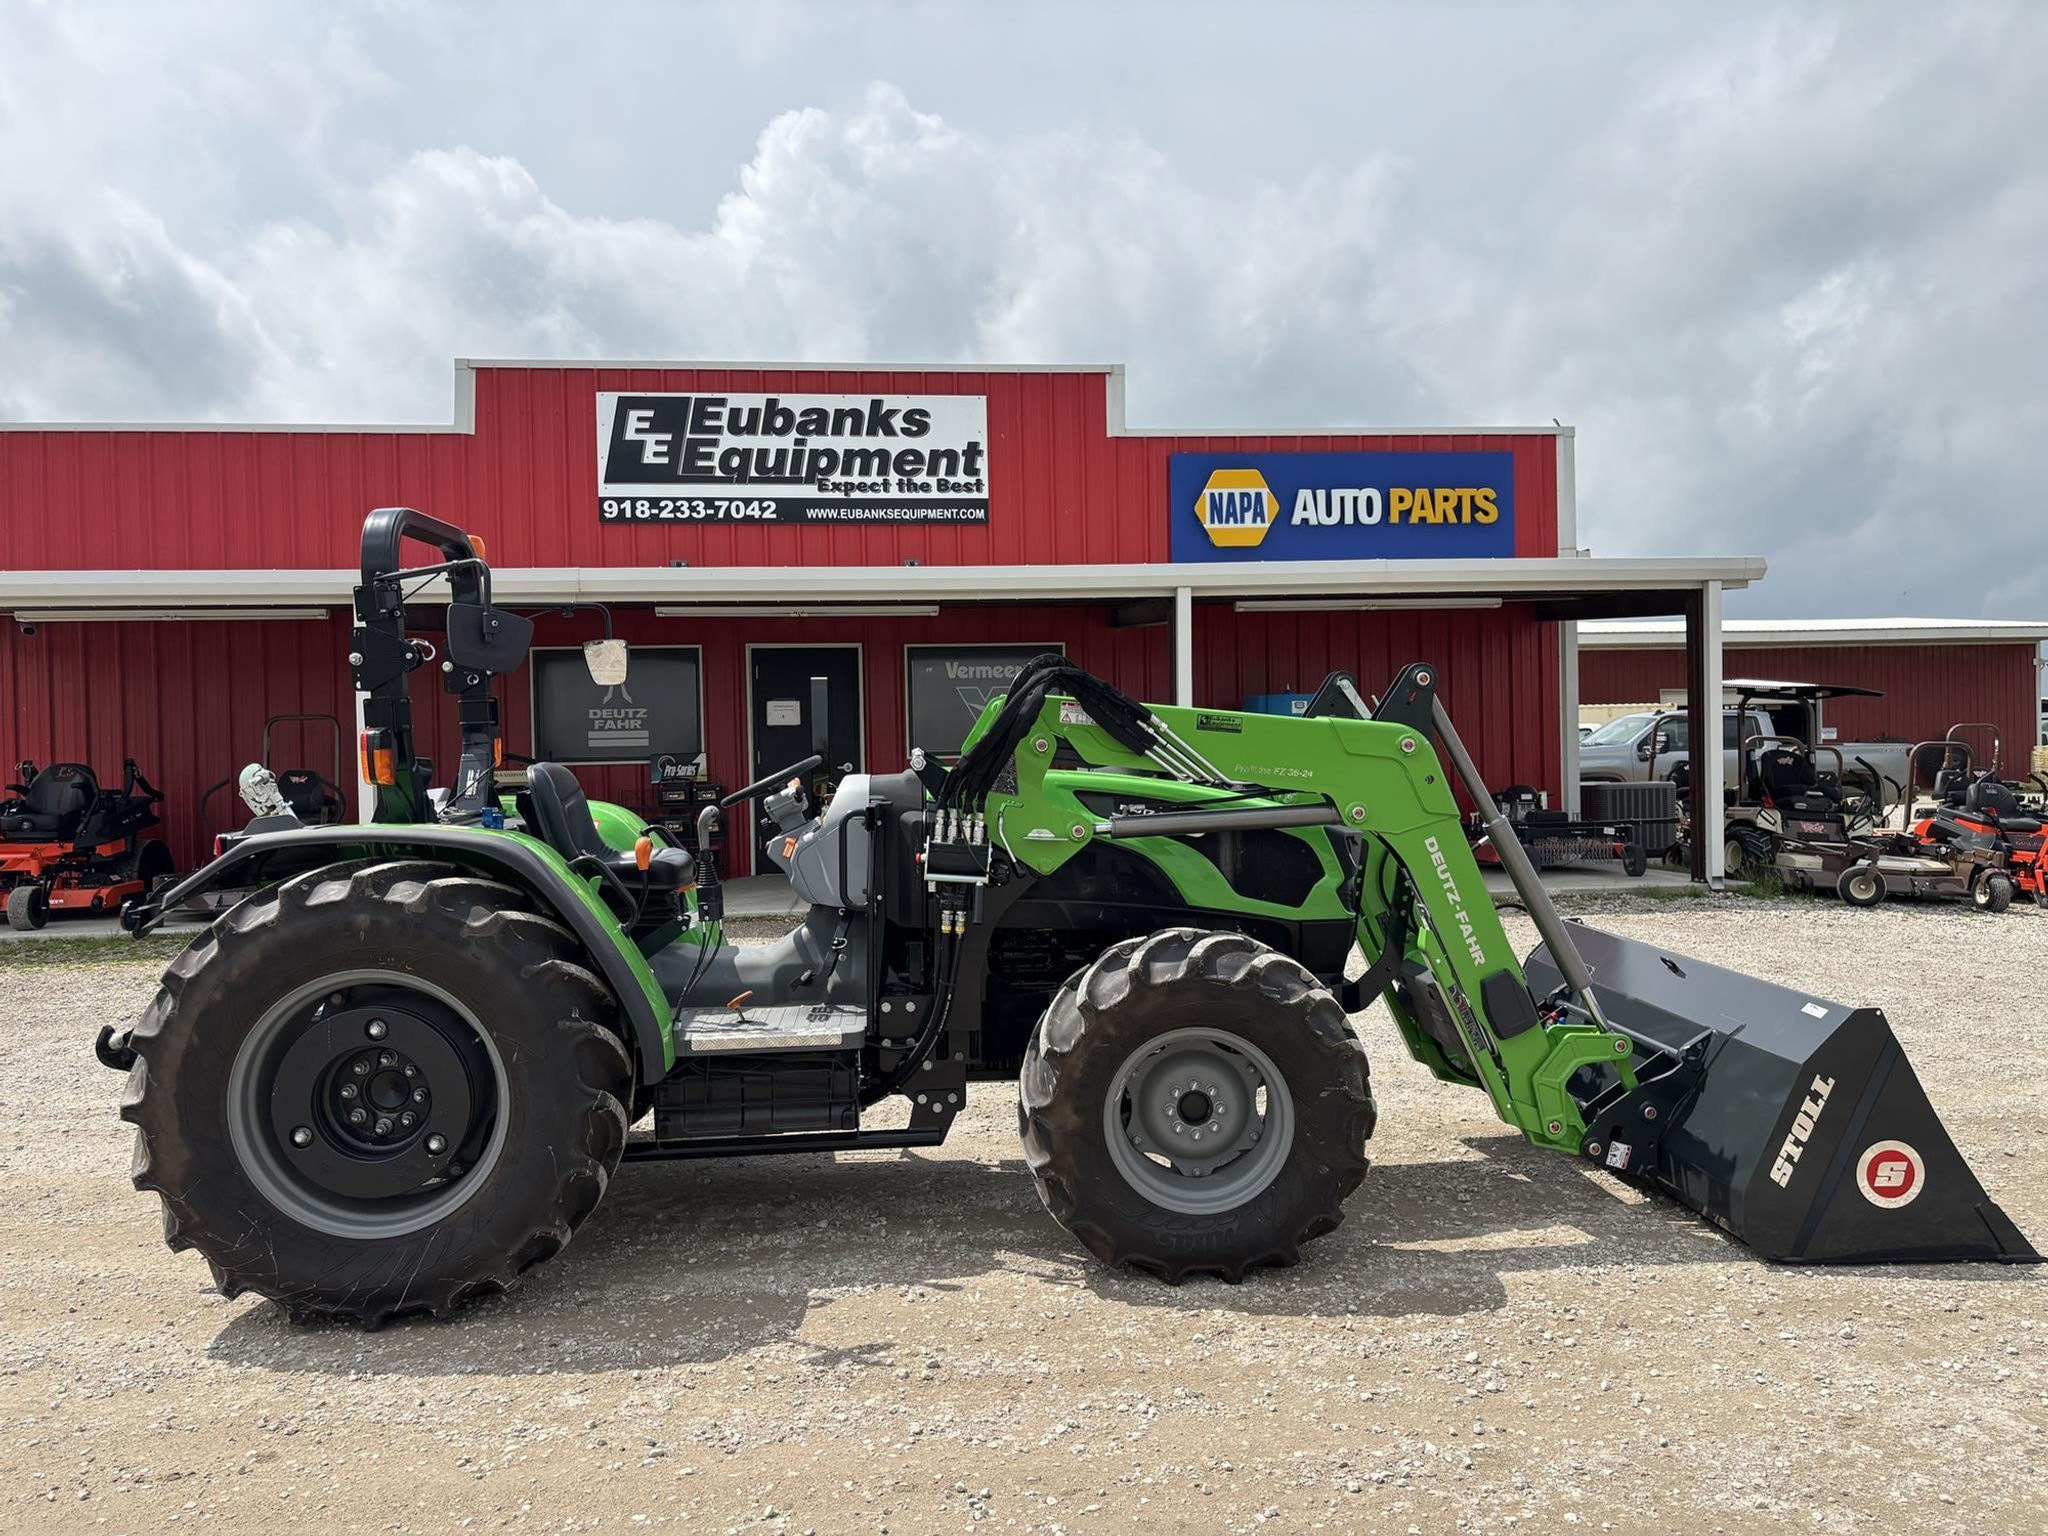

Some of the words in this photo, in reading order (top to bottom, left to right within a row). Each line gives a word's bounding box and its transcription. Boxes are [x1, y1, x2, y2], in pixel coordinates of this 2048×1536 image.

[689, 397, 931, 437] Eubanks
[679, 438, 985, 485] Equipment
[816, 478, 892, 497] Expect
[896, 478, 932, 493] the
[936, 479, 985, 494] Best
[603, 499, 777, 519] 918-233-7042
[806, 508, 985, 520] WWW.EUBANKSEQUIPMENT.COM
[1209, 492, 1266, 525] NAPA
[1291, 488, 1383, 526] AUTO
[1388, 488, 1499, 524] PARTS
[588, 708, 648, 719] DEUTZ
[593, 719, 642, 730] FAHR
[664, 764, 697, 777] Pro-Series
[1274, 767, 1286, 776] FZ
[1424, 835, 1485, 968] DEUTZ-FAHR
[1769, 1074, 1836, 1189] STOLL
[1873, 1161, 1908, 1187] S
